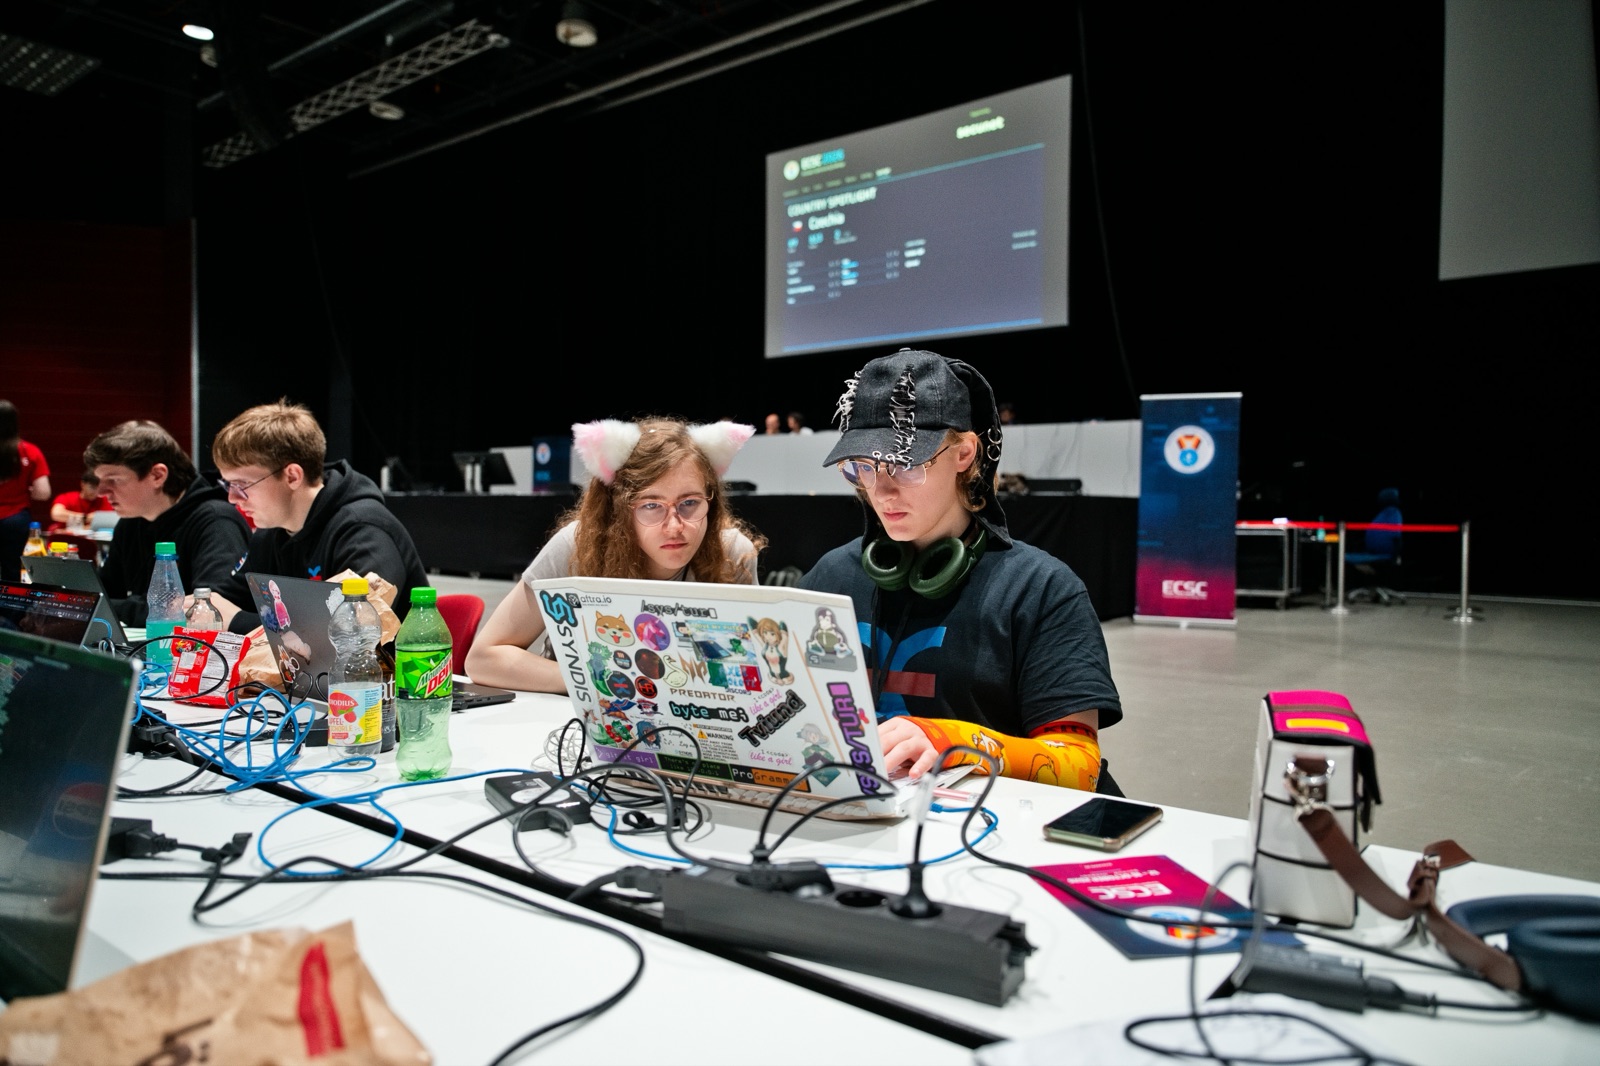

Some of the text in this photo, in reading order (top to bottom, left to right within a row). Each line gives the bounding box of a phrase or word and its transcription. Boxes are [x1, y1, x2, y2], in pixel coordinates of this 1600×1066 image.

[1162, 579, 1208, 597] ECSC
[556, 624, 592, 703] SYNDIS
[670, 687, 736, 702] PREDATOR
[671, 702, 747, 721] byte me;
[706, 732, 734, 741] WARNING
[750, 751, 766, 761] like
[776, 758, 792, 766] girl
[1088, 881, 1172, 900] ECSC
